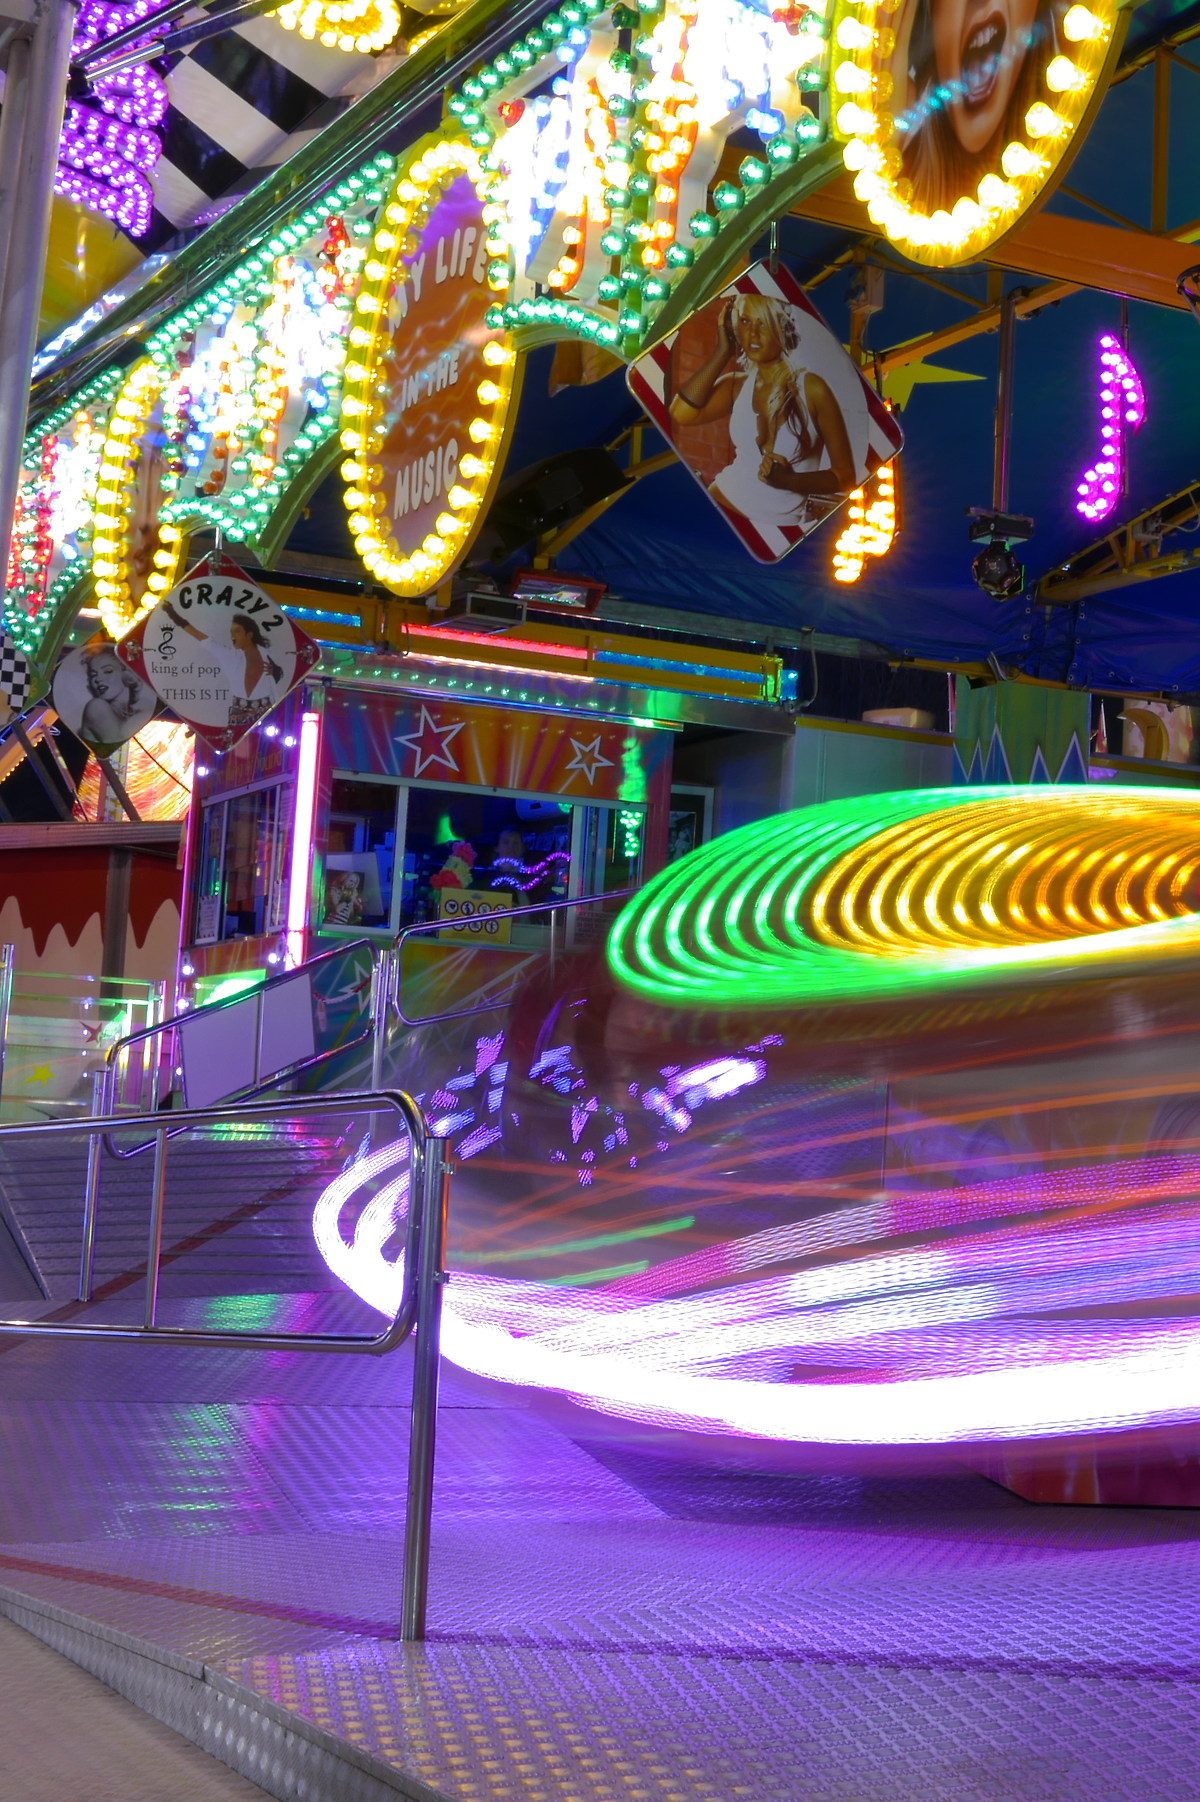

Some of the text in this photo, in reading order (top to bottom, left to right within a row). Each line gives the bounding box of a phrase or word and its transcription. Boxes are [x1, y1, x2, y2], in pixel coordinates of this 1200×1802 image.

[435, 227, 489, 284] LIFE
[401, 350, 460, 412] IN THE
[393, 437, 459, 520] MUSIC
[179, 583, 284, 632] CRAZY 2
[151, 662, 221, 678] king of pop
[162, 688, 230, 700] THIS IS IT
